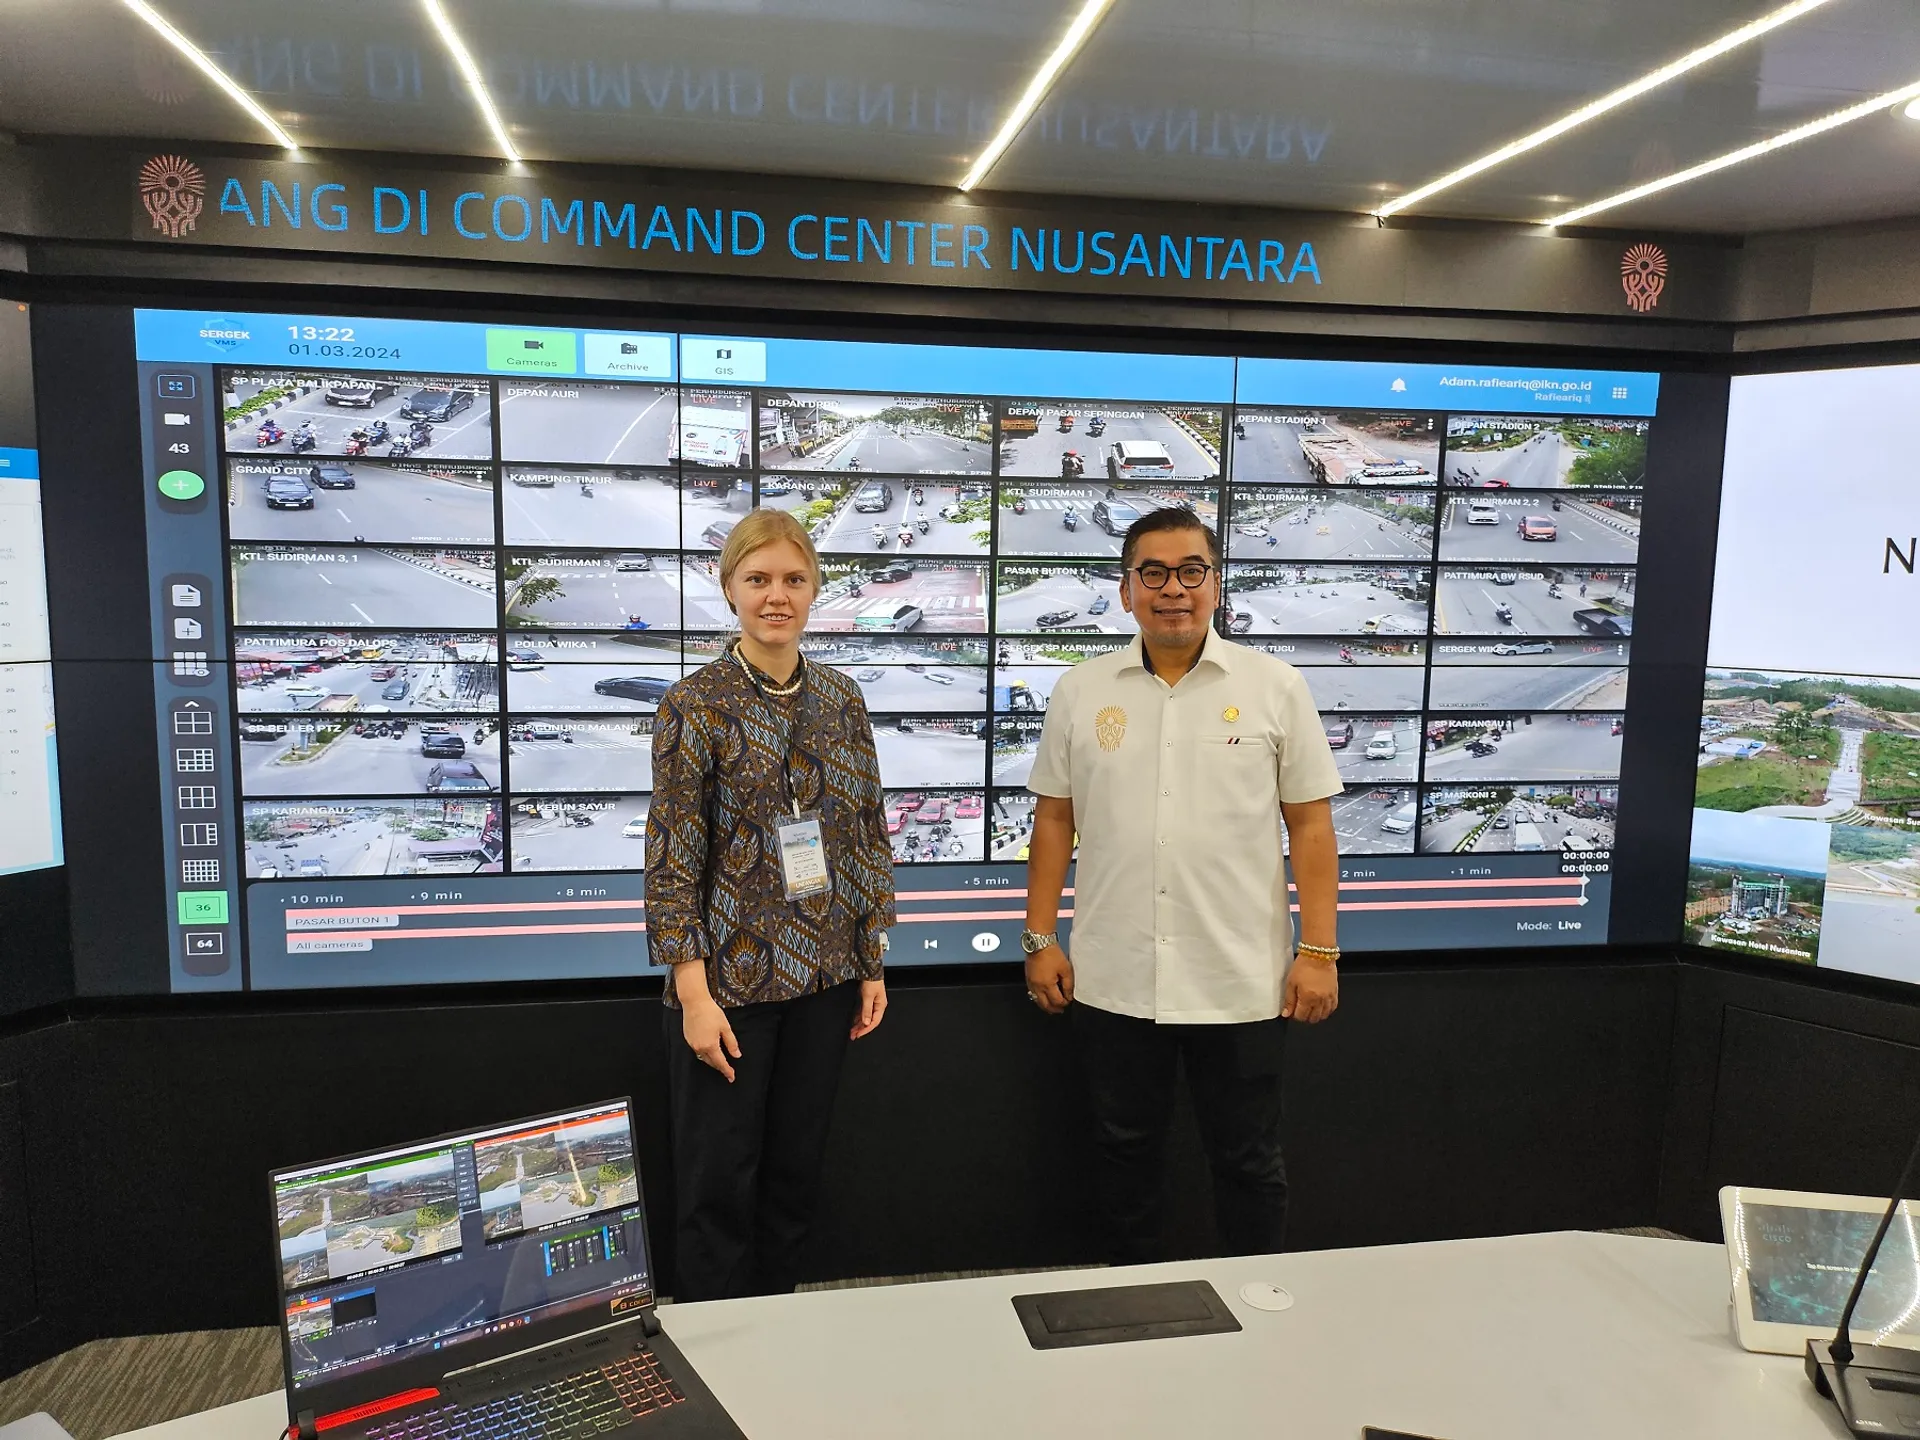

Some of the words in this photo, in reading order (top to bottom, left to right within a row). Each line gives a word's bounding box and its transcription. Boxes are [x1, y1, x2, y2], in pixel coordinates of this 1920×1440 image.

[219, 177, 349, 232] ANG
[373, 187, 429, 236] DI
[453, 191, 767, 257] COMMAND
[788, 214, 992, 269] CENTER
[1010, 226, 1323, 286] NUSANTARA
[200, 329, 250, 340] SERGEK
[288, 325, 356, 342] 13:22
[288, 344, 402, 360] 01.03.2024
[507, 357, 558, 368] Cameras
[607, 362, 649, 372] Archive
[715, 367, 734, 375] GIS
[231, 377, 249, 386] SP
[252, 378, 294, 388] PLAZA
[297, 379, 375, 390] BALIKPAPAN
[507, 388, 549, 397] DEPAN
[551, 390, 579, 399] AURI
[693, 396, 717, 404] LIVE
[768, 399, 806, 408] DEPAN
[1008, 407, 1044, 416] DEPAN
[1046, 408, 1081, 417] PASAR
[1083, 409, 1145, 420] SEPINGGAN
[1238, 415, 1272, 423] DEPAN
[1274, 416, 1318, 425] STADION
[1455, 421, 1488, 429] DEPAN
[1490, 421, 1525, 430] STADION
[168, 443, 190, 454] 43
[236, 465, 281, 475] GRAND
[284, 466, 313, 475] CITY
[510, 473, 571, 483] KAMPUNG
[574, 475, 612, 484] TIMUR
[693, 480, 718, 488] LIVE
[768, 482, 815, 491] KARANG
[818, 483, 841, 491] JATI
[1006, 488, 1026, 496] KTL
[1029, 489, 1085, 497] SUDIRMAN
[1234, 493, 1253, 501] KTL
[1255, 493, 1309, 502] SUDIRMAN
[1449, 497, 1465, 505] KTL
[1467, 497, 1521, 506] SUDIRMAN
[239, 552, 264, 561] KTL
[267, 553, 334, 563] SUDIRMAN
[1882, 537, 1917, 574] N
[512, 557, 532, 566] KTL
[537, 558, 601, 567] SUDIRMAN
[1004, 566, 1039, 575] PASAR
[1041, 567, 1077, 575] BUTON
[1231, 569, 1264, 578] PASAR
[1266, 570, 1300, 578] BUTON
[1444, 572, 1501, 580] PATTIMURA
[1518, 573, 1544, 581] RSUD
[244, 638, 317, 647] PATTIMURA
[320, 639, 345, 648] POS
[349, 639, 398, 648] DALOPS
[515, 640, 556, 649] POLDA
[559, 640, 588, 649] WIKA
[934, 643, 957, 651] LIVE
[1003, 644, 1043, 652] SERGEK
[1439, 645, 1477, 653] SERGEK
[248, 724, 266, 733] SP
[269, 724, 314, 733] BELLER
[317, 724, 342, 733] PTZ
[534, 723, 585, 732] GUNUNG
[587, 723, 638, 732] MALANG
[1000, 722, 1014, 730] SP
[1435, 720, 1447, 728] SP
[1429, 791, 1442, 799] SP
[1444, 791, 1489, 799] MARKONI
[999, 796, 1014, 804] SP
[1015, 796, 1027, 804] LE
[252, 807, 268, 816] SP
[270, 806, 345, 816] KARIANGAU
[347, 806, 356, 815] 2
[518, 803, 534, 812] SP
[536, 803, 576, 811] KEBUN
[578, 803, 616, 811] SAYUR
[1562, 851, 1610, 860] 00:00:00
[1469, 867, 1492, 875] min
[1561, 864, 1609, 873] 00:00:00
[1341, 870, 1349, 878] 2
[1353, 869, 1376, 877] min
[973, 877, 981, 886] 5
[985, 876, 1009, 885] min
[420, 891, 429, 901] 9
[435, 890, 463, 900] min
[566, 888, 574, 896] 8
[580, 887, 606, 896] min
[291, 894, 309, 904] 10
[315, 893, 344, 903] min
[196, 903, 211, 912] 36
[295, 917, 335, 927] PASAR
[338, 916, 379, 926] BUTON
[1516, 921, 1552, 931] Mode:
[1558, 921, 1582, 931] Live
[197, 939, 214, 949] 64
[296, 940, 312, 950] All
[313, 940, 364, 949] cameras
[1710, 934, 1747, 947] Kawasan
[1748, 940, 1768, 950] Hotel
[1770, 944, 1811, 958] Nusantara
